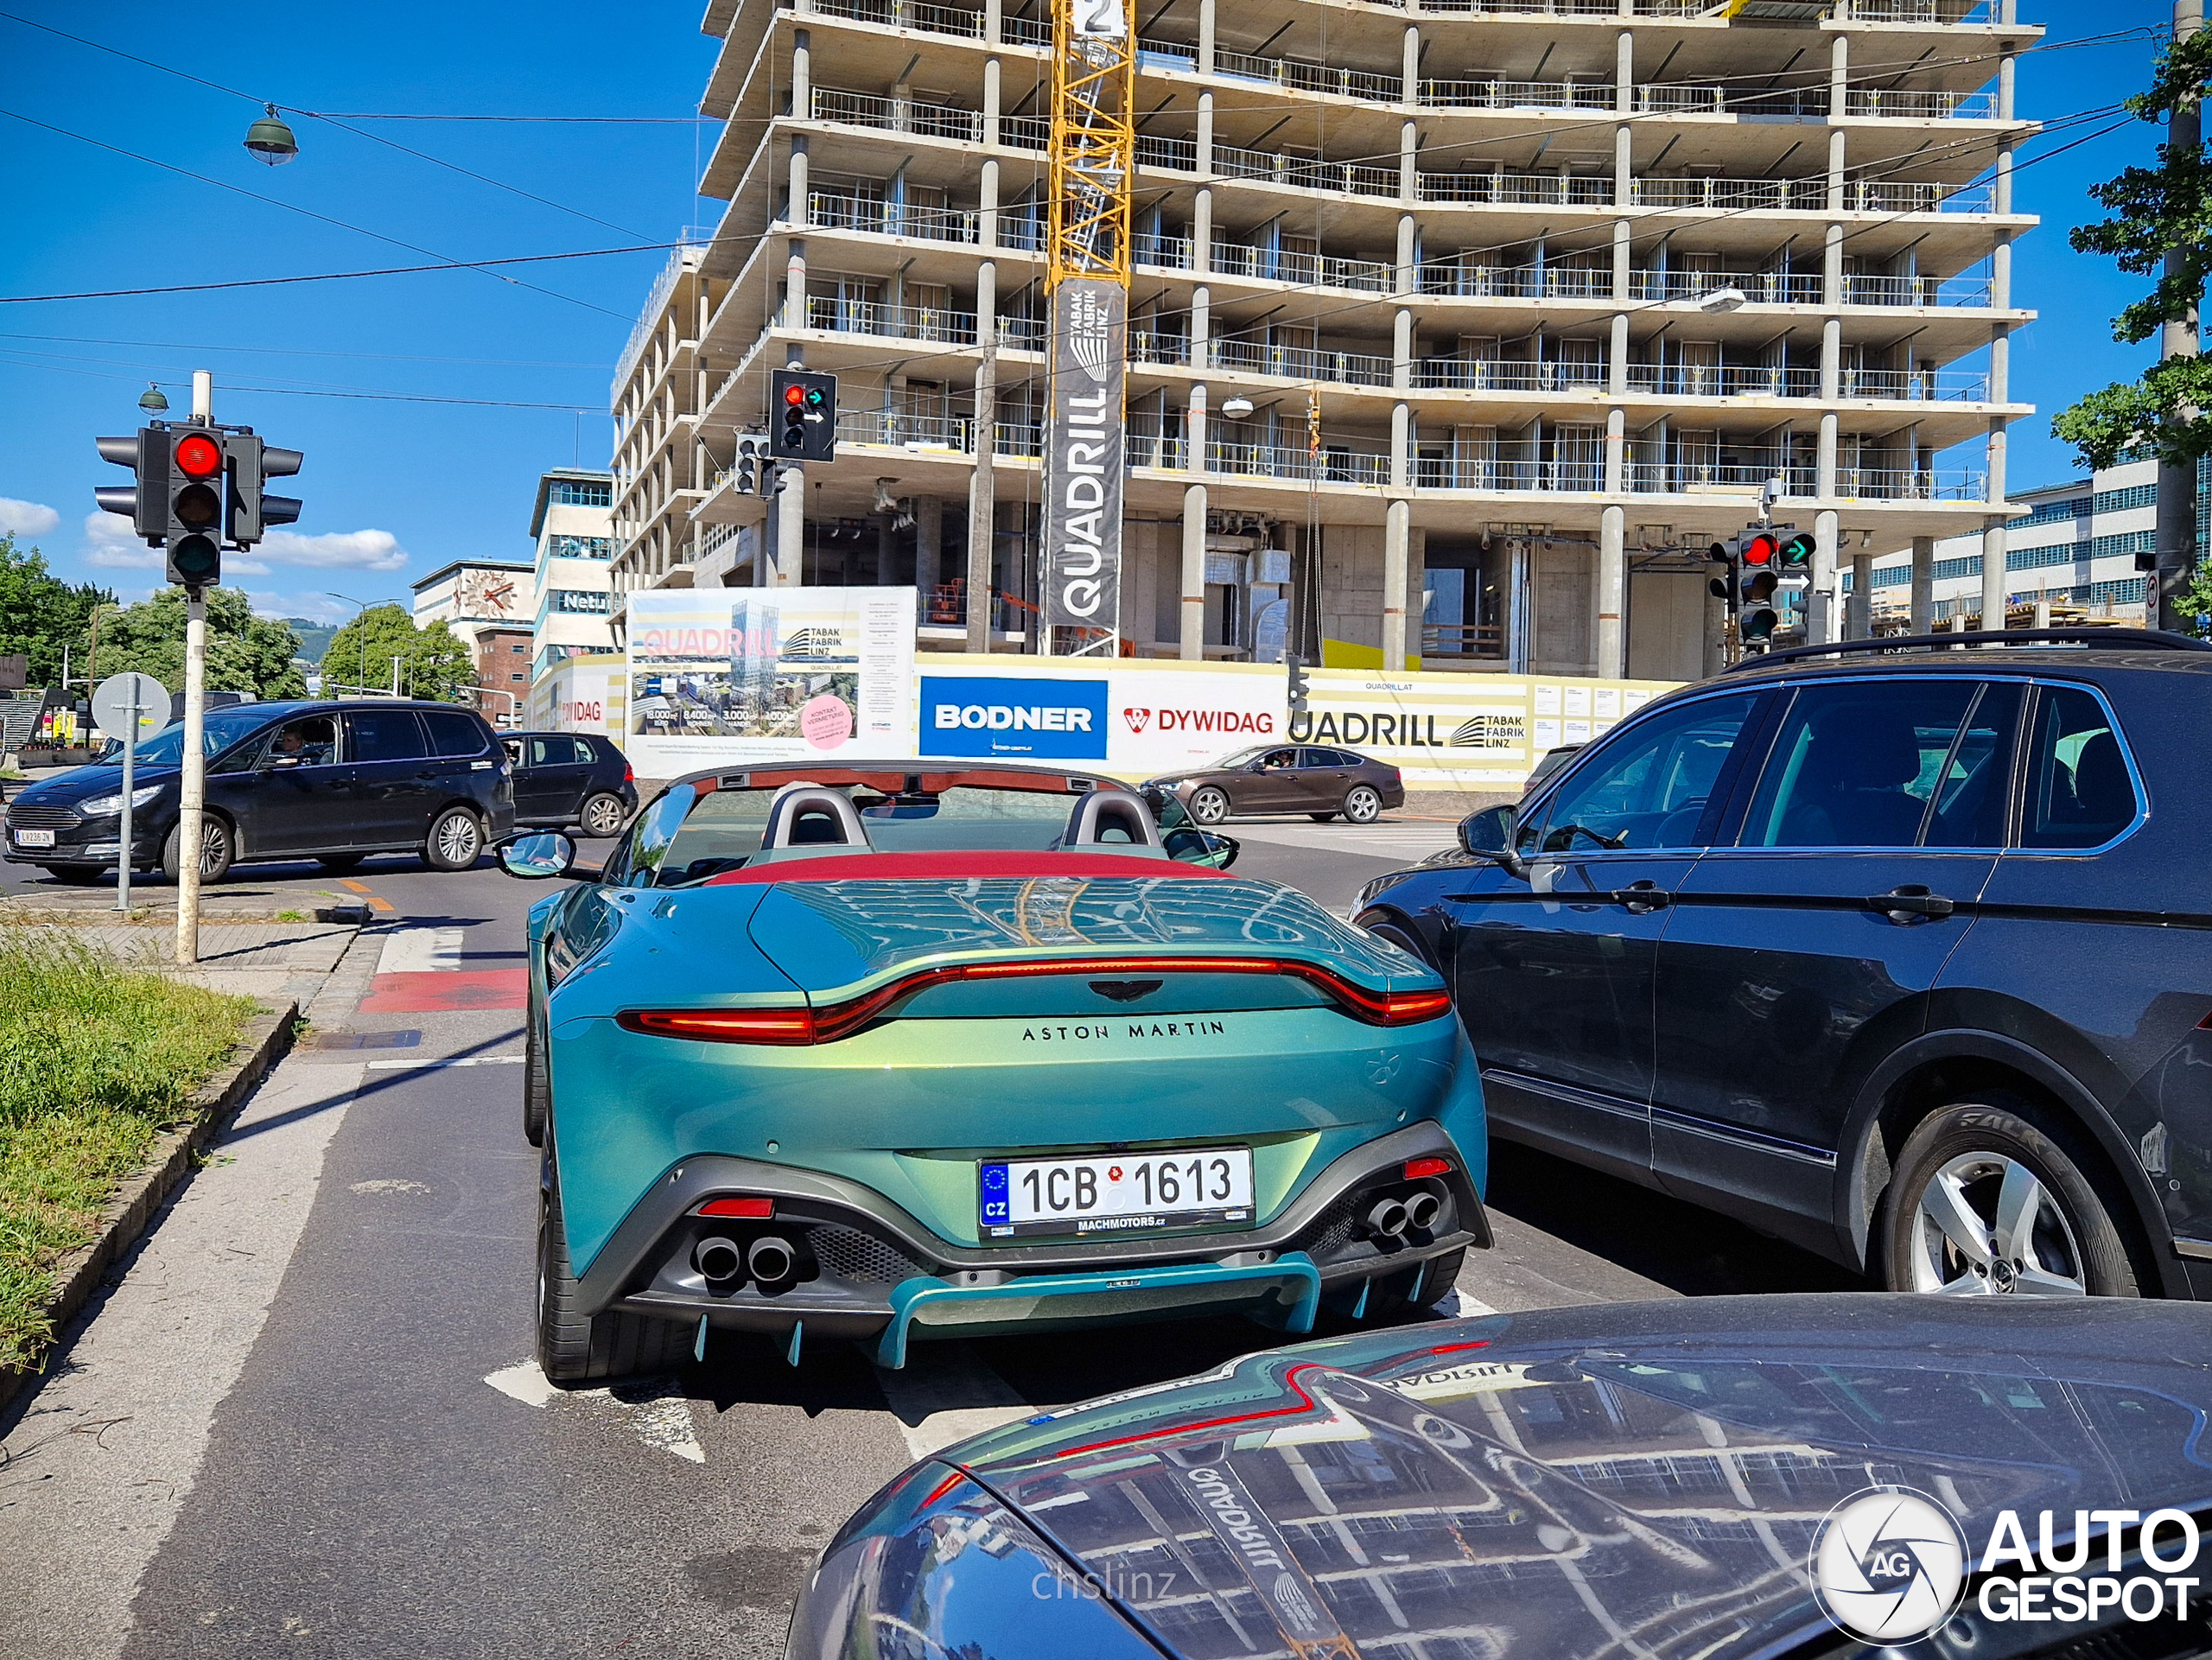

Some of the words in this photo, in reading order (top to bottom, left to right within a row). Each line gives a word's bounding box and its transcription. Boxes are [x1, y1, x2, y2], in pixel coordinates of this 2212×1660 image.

[1084, 0, 1111, 32] 2
[1071, 292, 1082, 336] TABAK
[1084, 289, 1096, 338] FABRIK
[1096, 307, 1109, 339] LINZ
[1063, 388, 1106, 617] QUADRILL
[645, 629, 777, 657] QUADRILL
[810, 638, 842, 646] FABRIK
[811, 706, 837, 718] KONTAKT
[935, 704, 1092, 732] BODNER
[1159, 709, 1273, 734] DYWIDAG
[1486, 716, 1522, 726] TABAK
[1486, 727, 1524, 737] FABRIK
[1486, 738, 1510, 748] LINZ
[1022, 1026, 1109, 1040] ASTON
[1128, 1021, 1224, 1038] MARTIN
[1023, 1167, 1097, 1212] 1CB
[1135, 1159, 1230, 1205] 1613
[986, 1202, 1006, 1217] CZ
[1078, 1216, 1166, 1231] MACHMOTORS.cz
